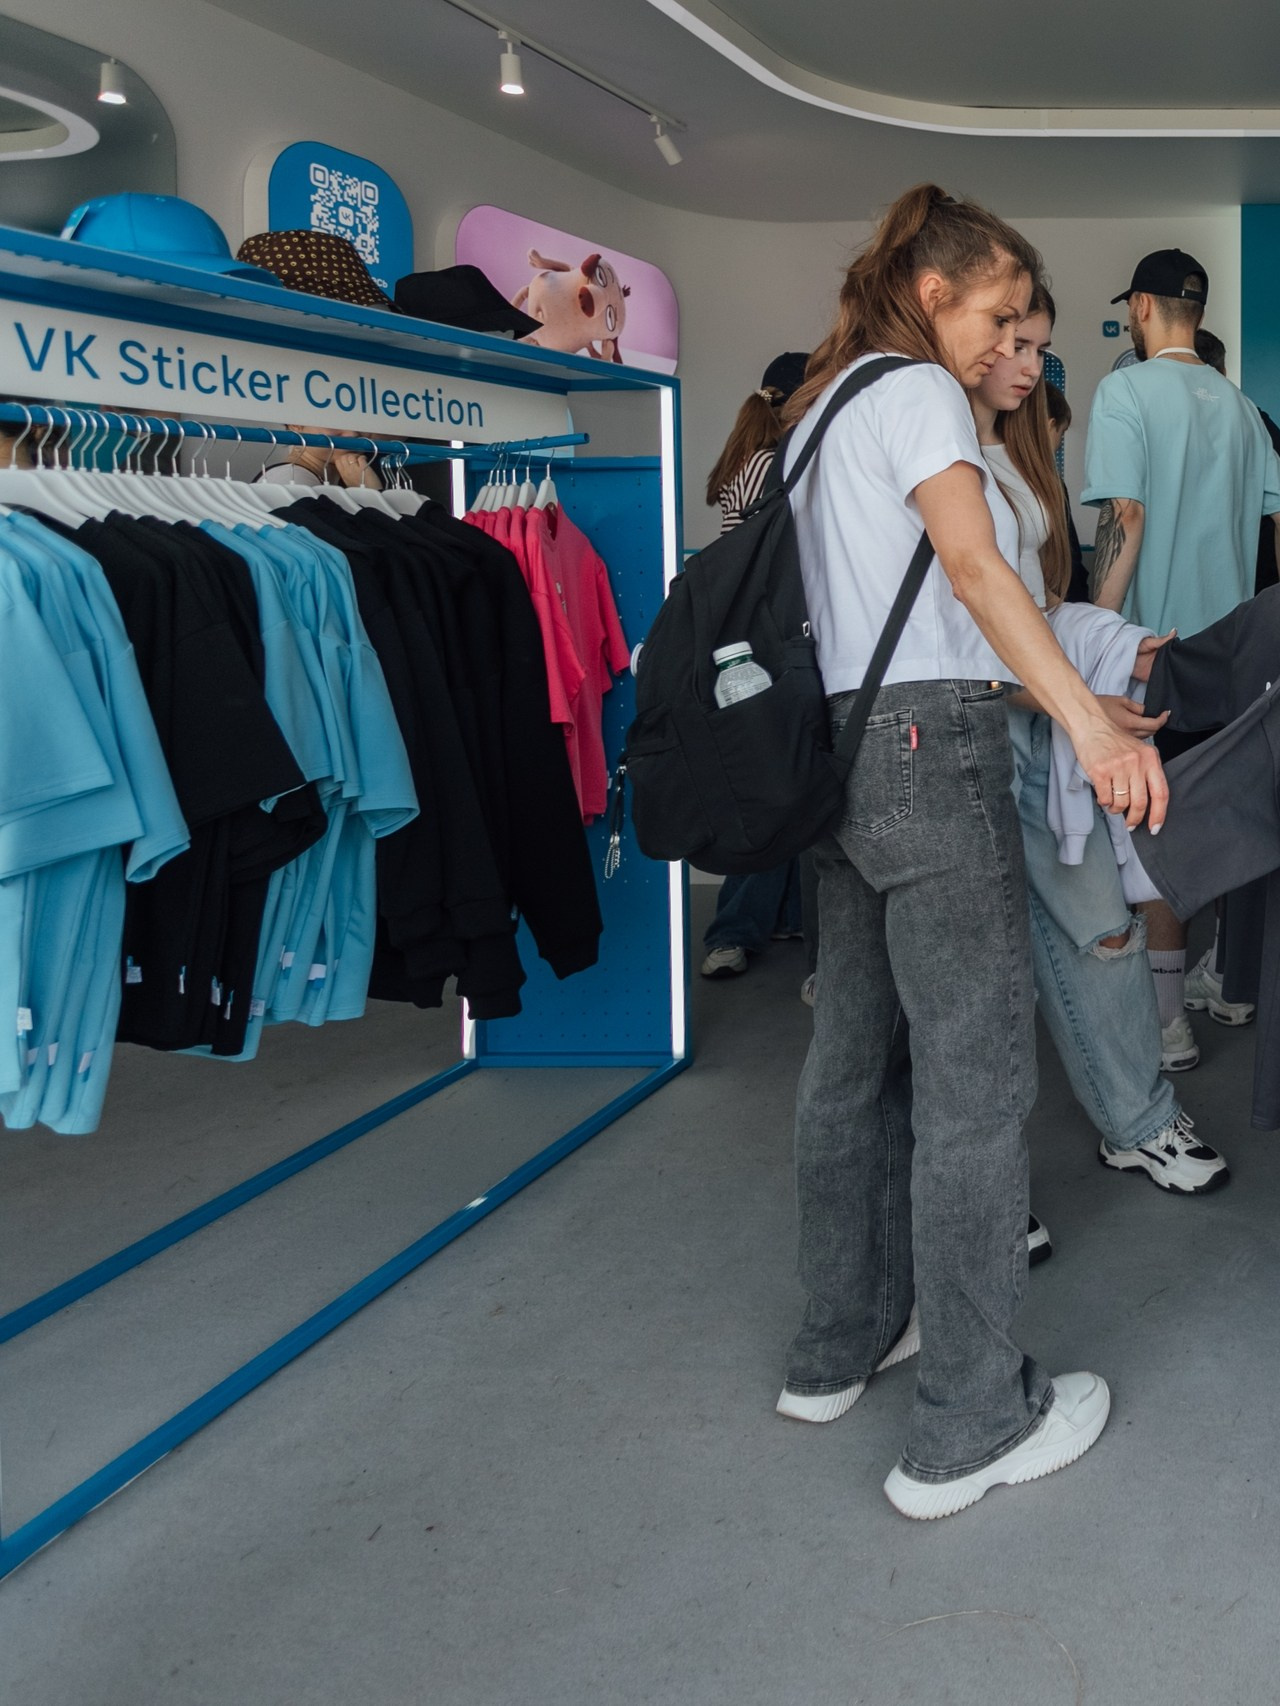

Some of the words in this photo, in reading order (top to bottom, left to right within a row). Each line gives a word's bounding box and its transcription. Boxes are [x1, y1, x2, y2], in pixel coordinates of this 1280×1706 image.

[14, 322, 100, 380] VK
[119, 340, 290, 403] Sticker
[304, 369, 484, 428] Collection
